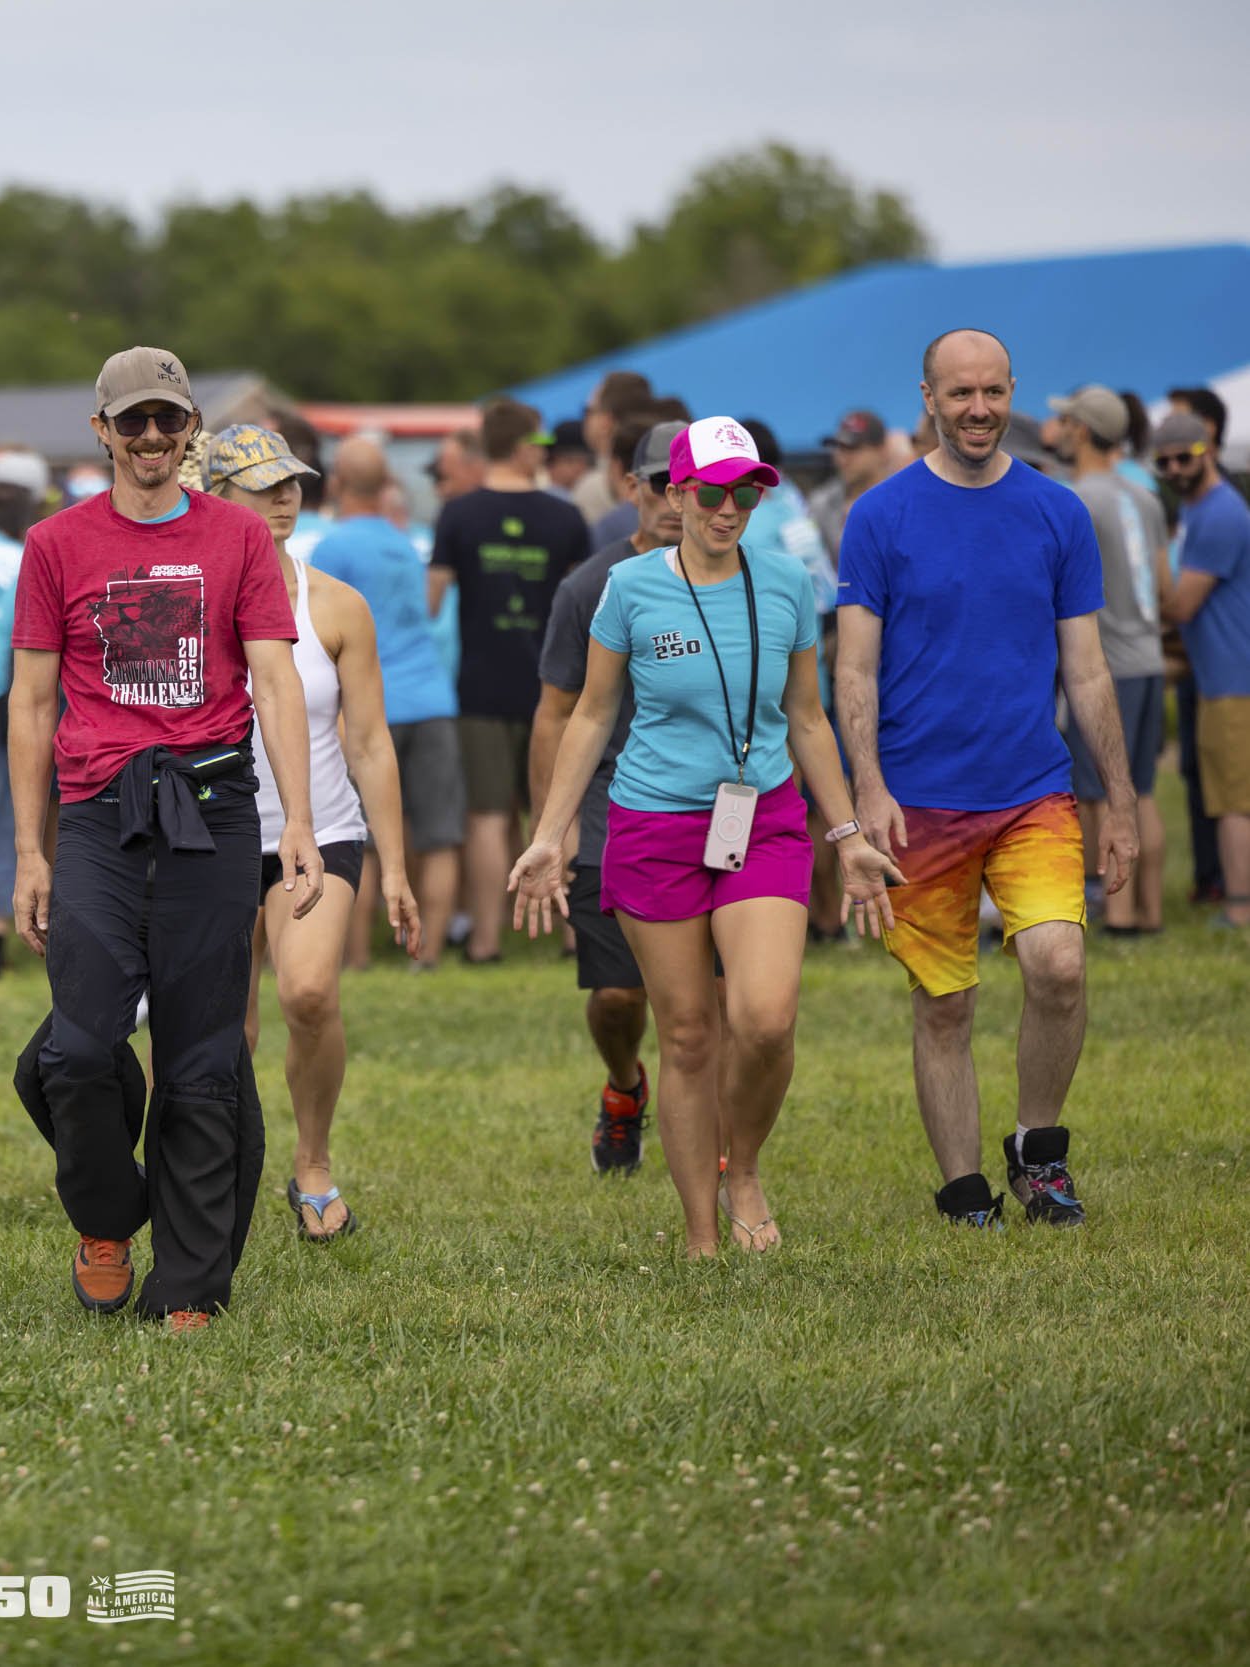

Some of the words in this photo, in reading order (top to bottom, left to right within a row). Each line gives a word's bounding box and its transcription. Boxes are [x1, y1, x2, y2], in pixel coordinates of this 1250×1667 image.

[178, 637, 198, 659] 20
[651, 631, 681, 646] THE
[654, 639, 702, 660] 250
[110, 659, 180, 684] ARIZONA
[178, 659, 198, 681] 25
[110, 681, 200, 706] CHALLENGE
